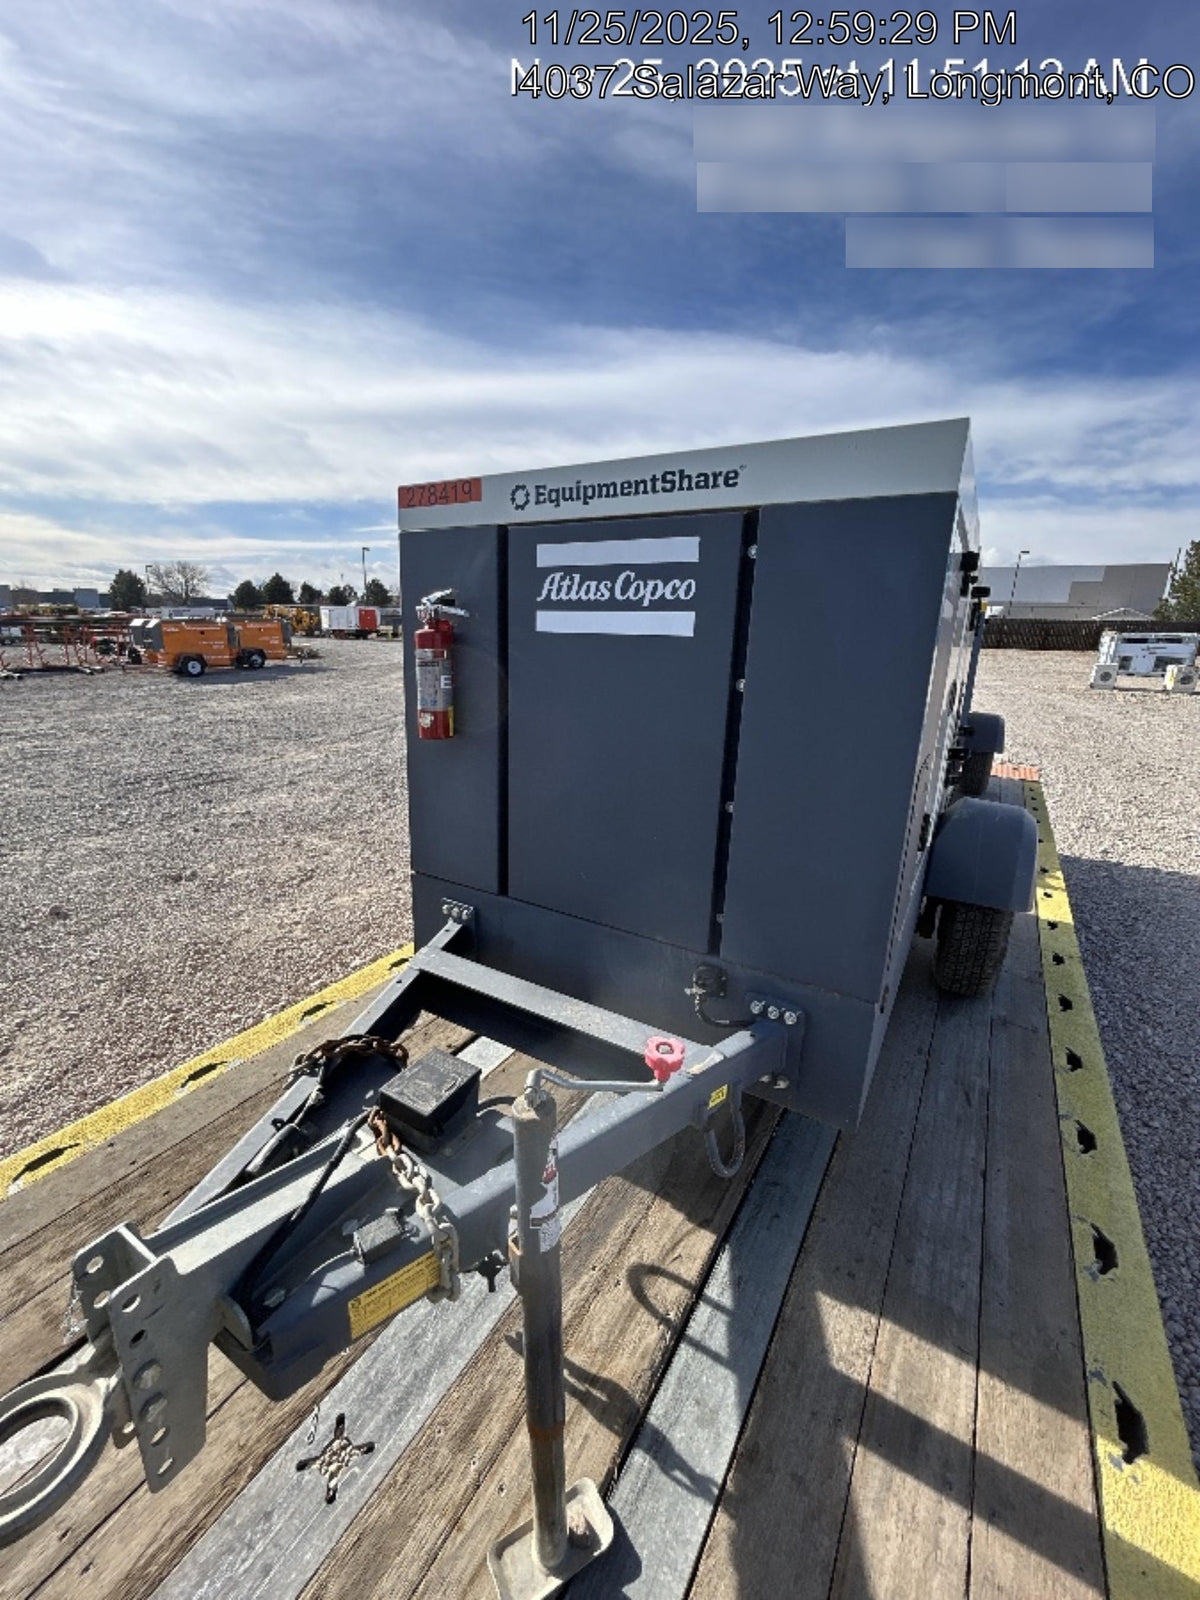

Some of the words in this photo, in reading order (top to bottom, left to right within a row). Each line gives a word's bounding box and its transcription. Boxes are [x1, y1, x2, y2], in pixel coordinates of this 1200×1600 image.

[405, 480, 473, 508] 278419
[534, 468, 740, 508] EquipmentShare
[536, 571, 611, 602] Atlas
[614, 570, 696, 607] Copco
